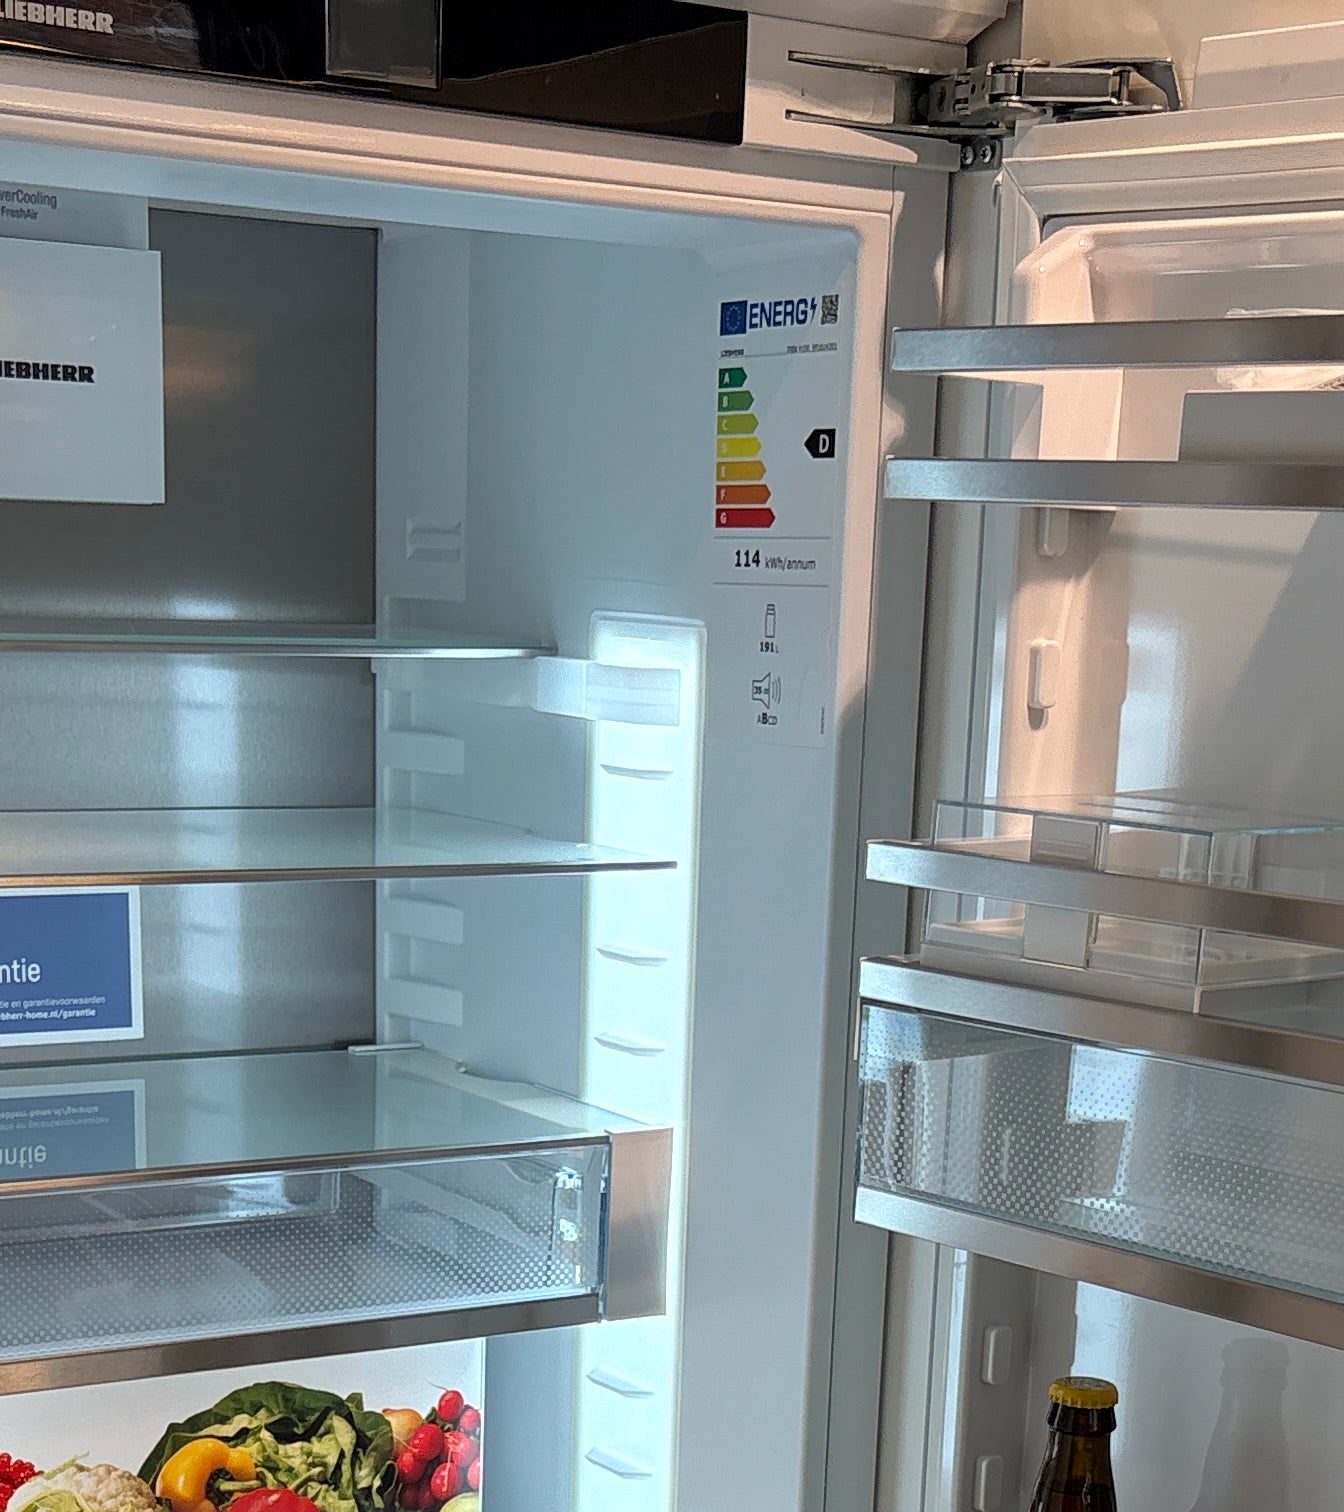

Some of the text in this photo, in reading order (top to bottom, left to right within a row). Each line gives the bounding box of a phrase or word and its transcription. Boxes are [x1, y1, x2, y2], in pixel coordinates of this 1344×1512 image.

[0, 205, 39, 220] FreshAir
[749, 298, 808, 329] ENERG
[722, 371, 731, 385] A
[721, 394, 730, 408] B
[818, 433, 831, 455] D
[719, 511, 728, 525] G
[735, 549, 817, 572] 114 kWh/annum
[760, 641, 774, 653] 191
[11, 999, 22, 1009] en
[23, 995, 106, 1010] garantievoorwaarden
